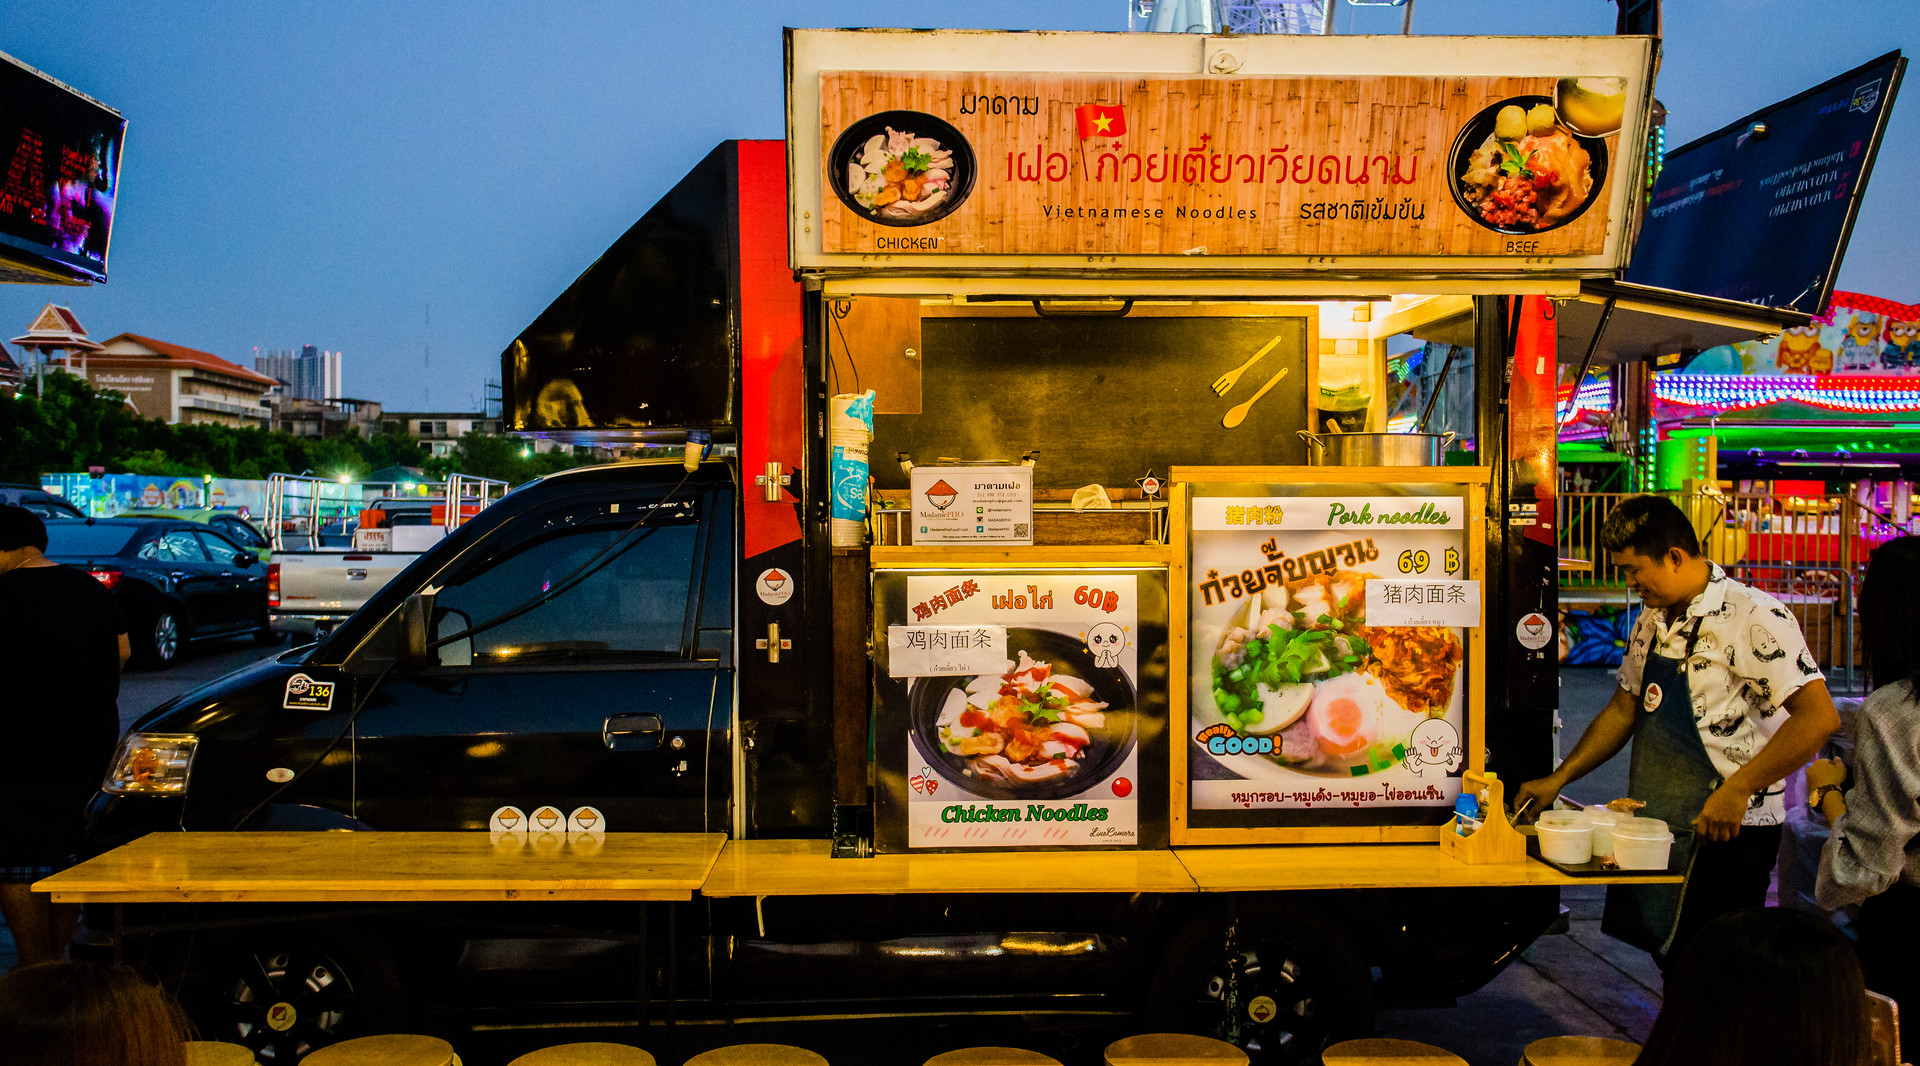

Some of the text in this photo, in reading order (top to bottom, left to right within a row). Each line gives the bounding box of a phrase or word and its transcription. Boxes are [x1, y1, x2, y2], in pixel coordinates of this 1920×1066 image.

[960, 95, 1039, 116] มาดาม
[1006, 132, 1418, 184] เฝอ ก๋วยเตี๋ยวเวียดนาม
[1043, 204, 1257, 219] Vietnamese Noodles
[1299, 197, 1425, 220] รสชาติเข้มข้น
[876, 236, 938, 250] CHICKEN
[1506, 240, 1539, 252] BEEF
[1226, 505, 1284, 526] 猪肉粉
[1327, 502, 1451, 527] Pork noodles
[1397, 549, 1430, 575] 69
[911, 579, 980, 622] 鸡肉面条
[1383, 584, 1466, 604] 猪肉面条
[906, 628, 991, 650] 鸡肉面条
[309, 685, 330, 697] 136
[1196, 723, 1237, 744] Really
[1207, 734, 1283, 756] GOOD!
[941, 804, 1109, 824] Chicken Noodles
